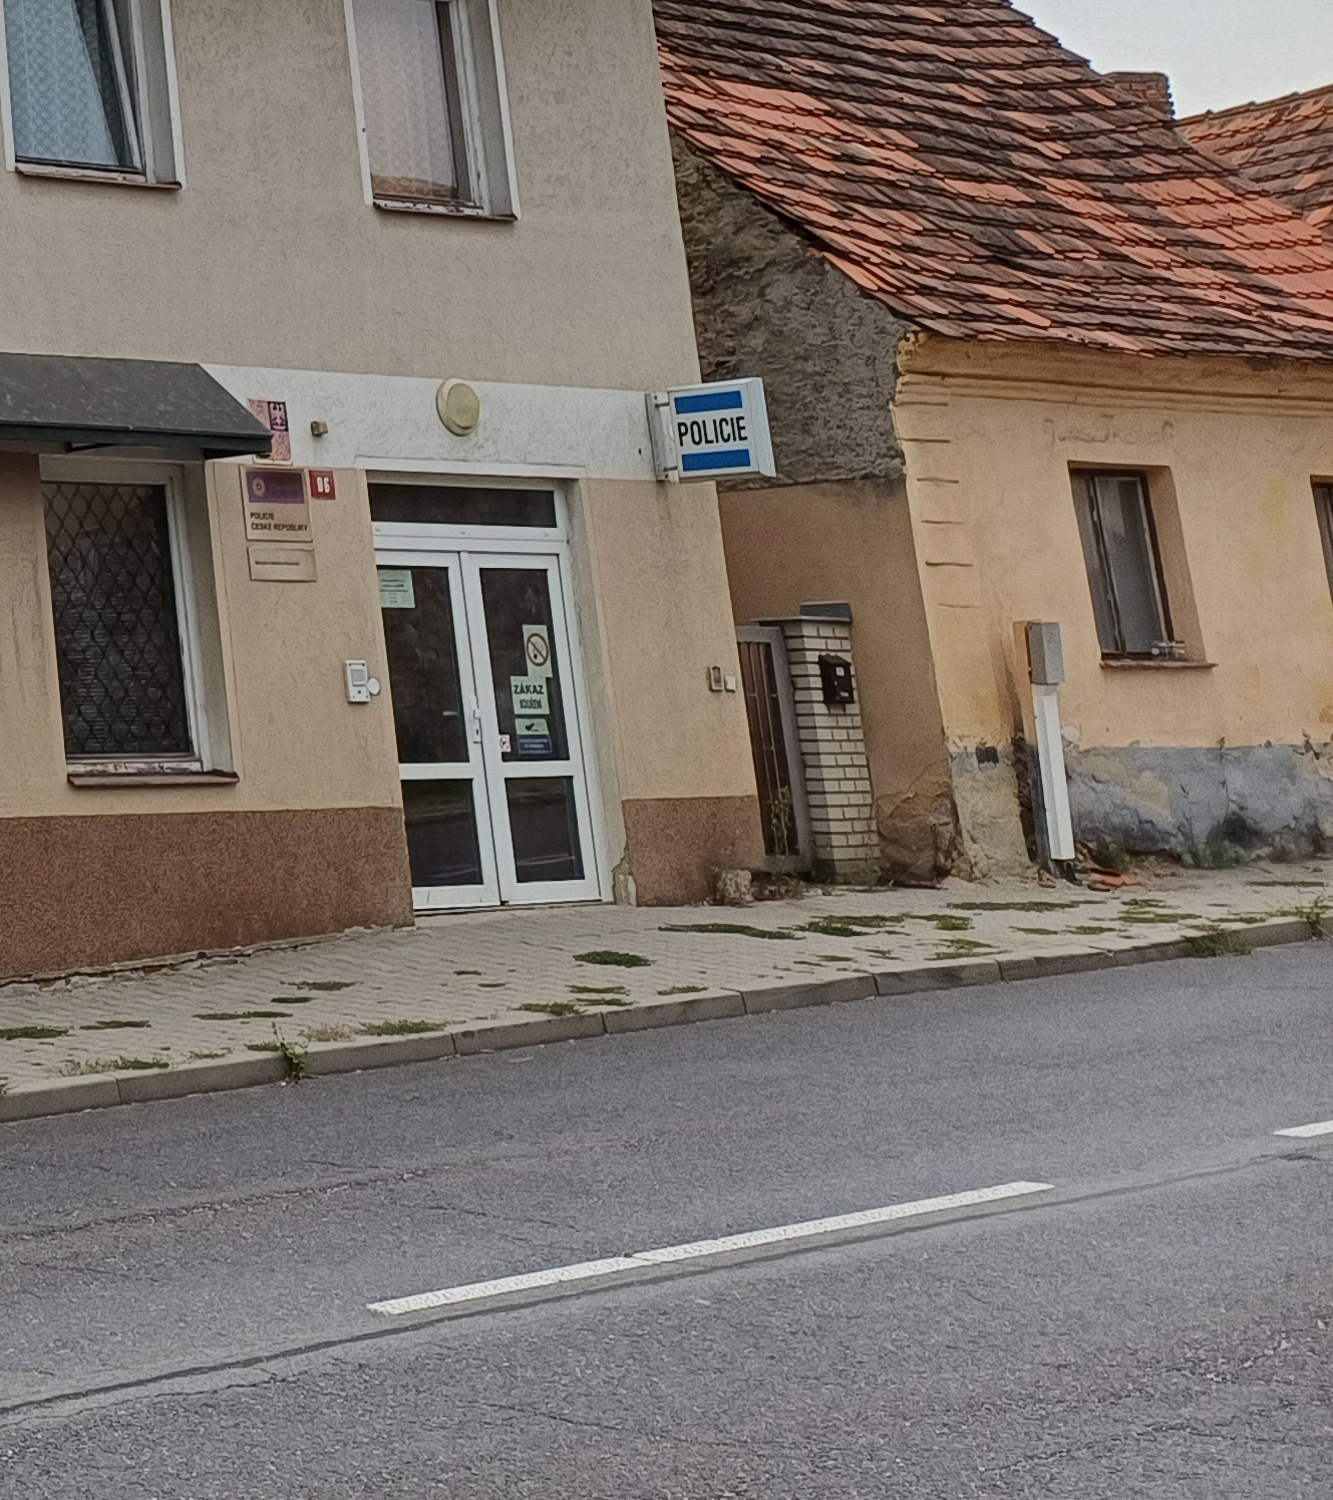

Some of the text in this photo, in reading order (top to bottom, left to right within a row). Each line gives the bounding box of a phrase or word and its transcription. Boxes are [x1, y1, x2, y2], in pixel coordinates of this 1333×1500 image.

[677, 415, 748, 447] POLICIE
[316, 476, 331, 493] 86
[250, 512, 274, 520] POLICIE
[513, 681, 544, 694] ZÁKAZ
